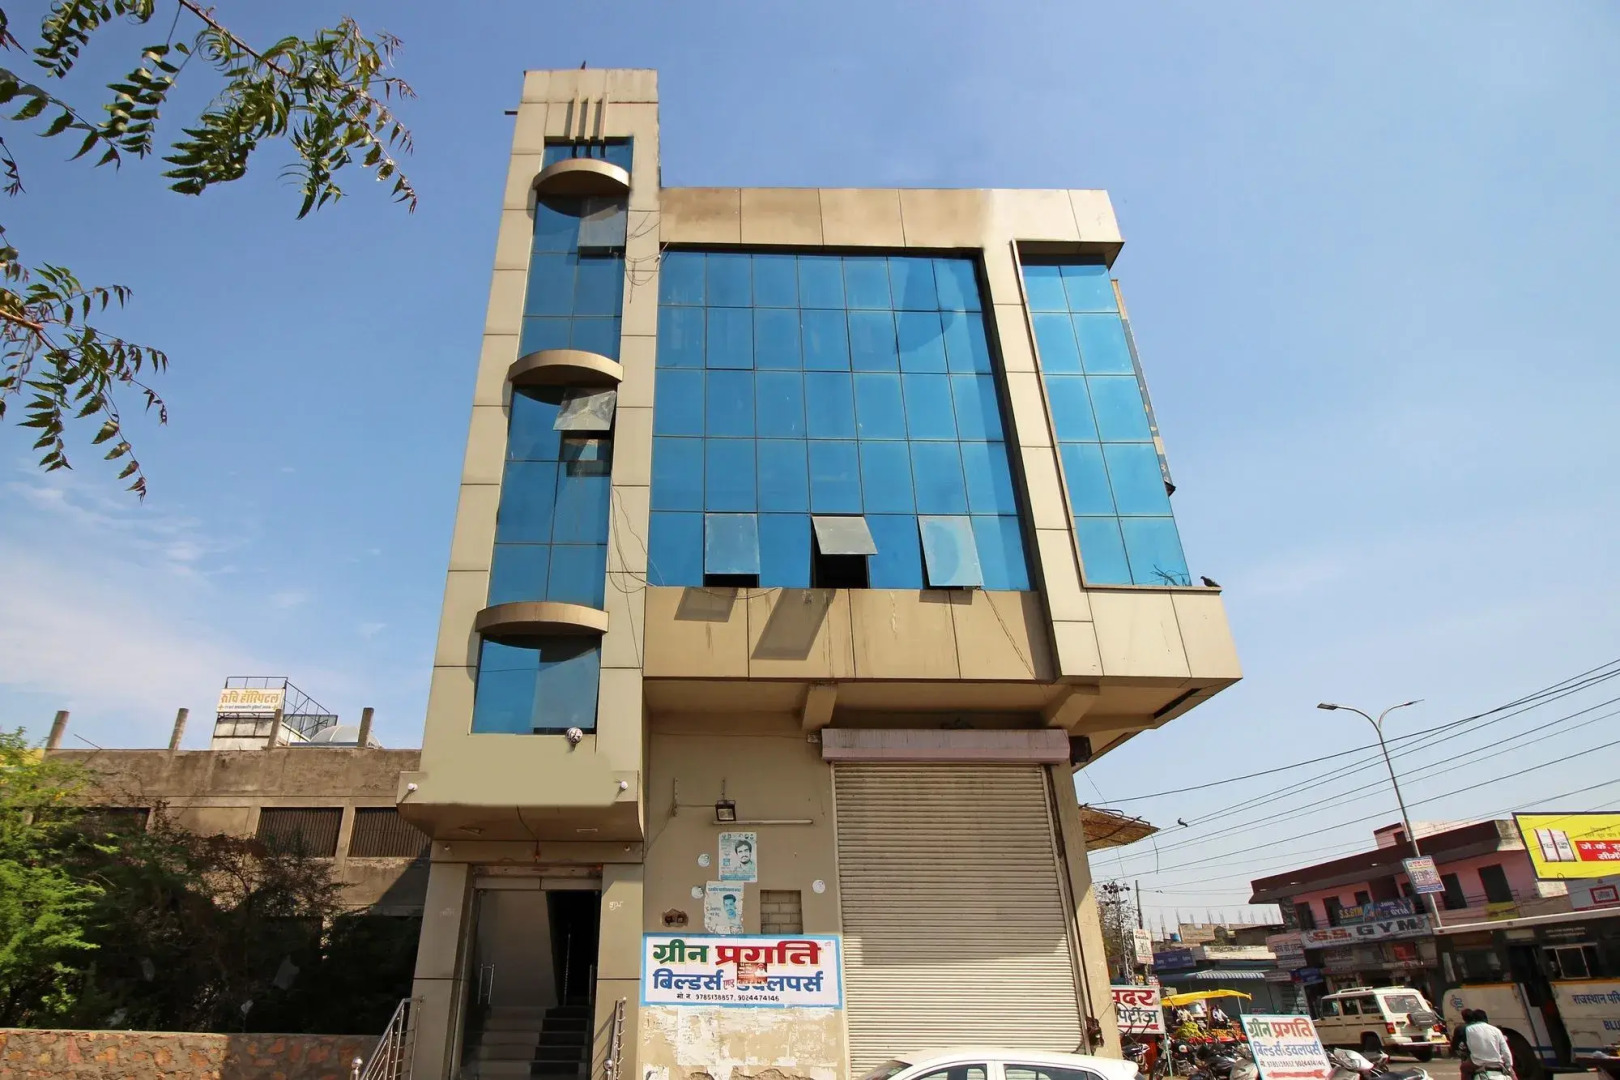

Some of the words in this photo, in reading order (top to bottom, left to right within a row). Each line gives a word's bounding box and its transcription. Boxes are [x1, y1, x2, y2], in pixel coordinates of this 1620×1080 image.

[1356, 918, 1418, 936] GYM
[653, 939, 709, 965] ग्रीन
[715, 941, 822, 966] प्रगति
[653, 968, 724, 991] बिल्डर्स
[1247, 1018, 1272, 1038] ग्रीन
[1271, 1018, 1313, 1038] प्रगति
